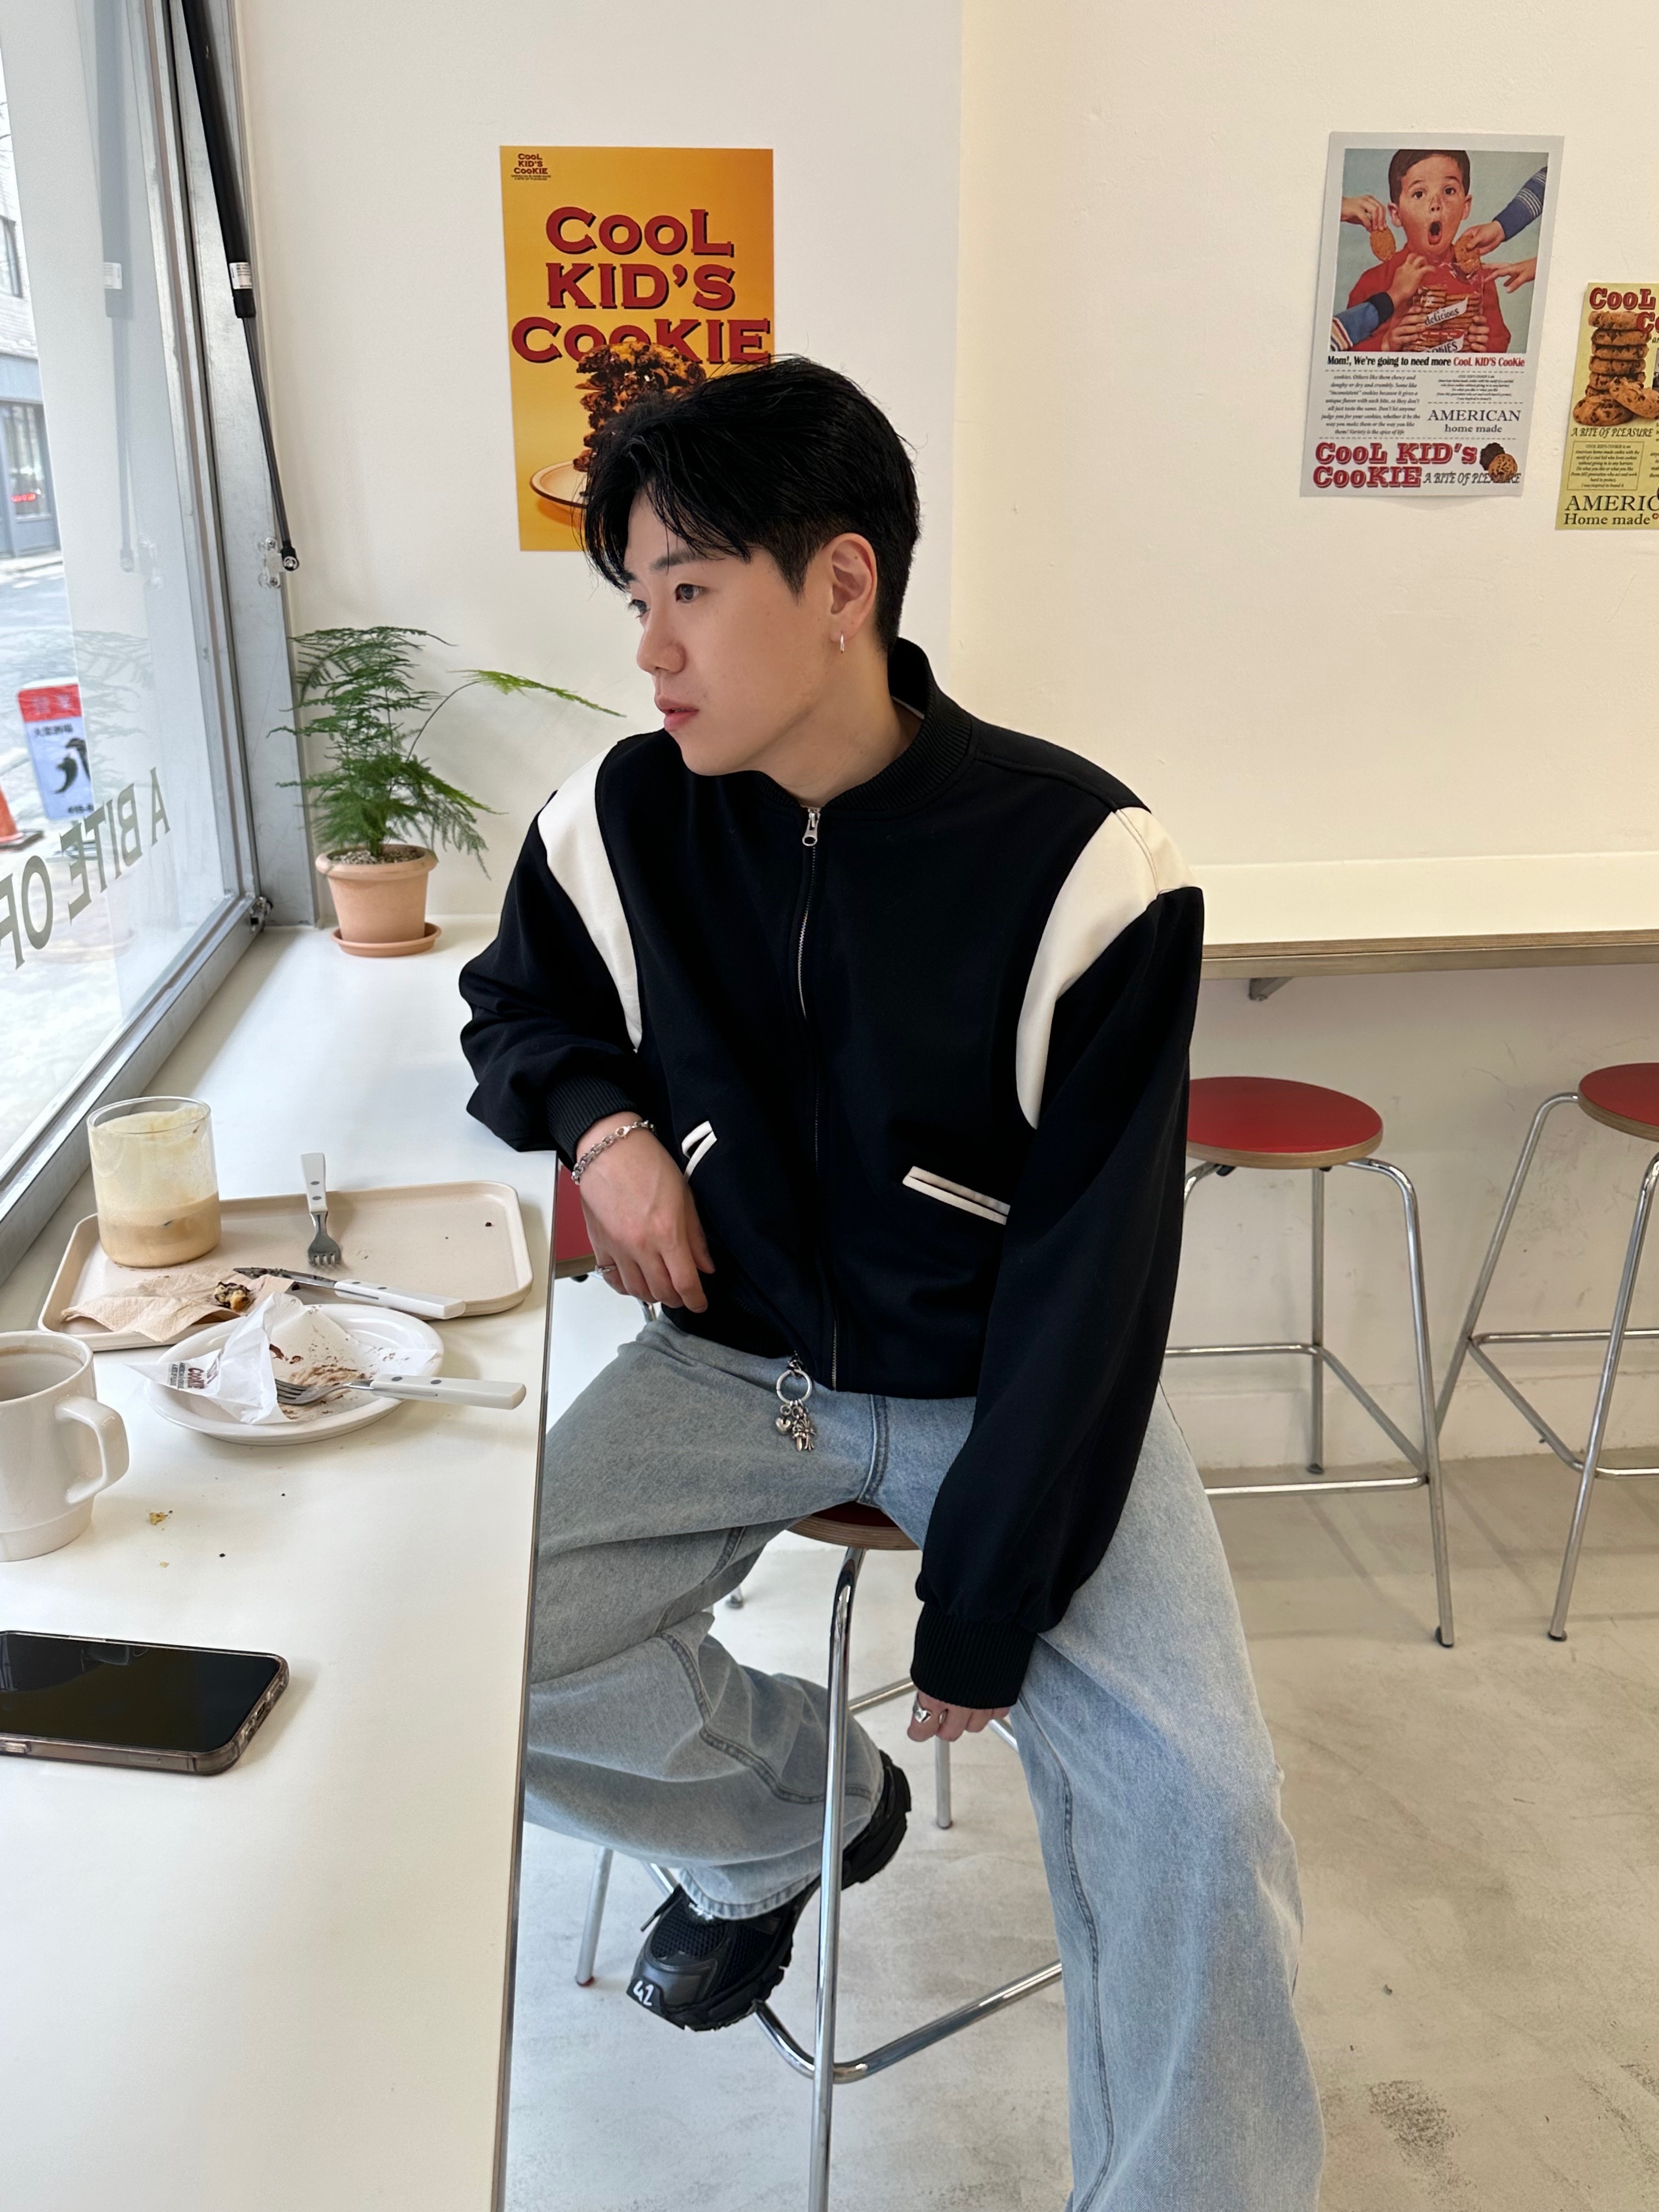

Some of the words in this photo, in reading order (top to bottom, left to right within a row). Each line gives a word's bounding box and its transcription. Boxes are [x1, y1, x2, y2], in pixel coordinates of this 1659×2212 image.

[546, 263, 735, 311] KID'S
[1425, 308, 1459, 325] delicious
[1354, 356, 1376, 365] We're
[1377, 357, 1400, 367] going
[1401, 357, 1408, 365] to
[1410, 357, 1429, 366] need
[1427, 410, 1521, 421] AMERICAN
[1444, 424, 1473, 432] home
[1571, 427, 1578, 437] A
[1579, 427, 1598, 437] BITE
[1599, 428, 1611, 438] OF
[1611, 428, 1654, 437] PLEASURE
[1423, 473, 1431, 483] A
[1434, 472, 1456, 483] BITE
[1458, 473, 1471, 486] OF
[1564, 513, 1608, 524] Home
[1612, 514, 1650, 524] made
